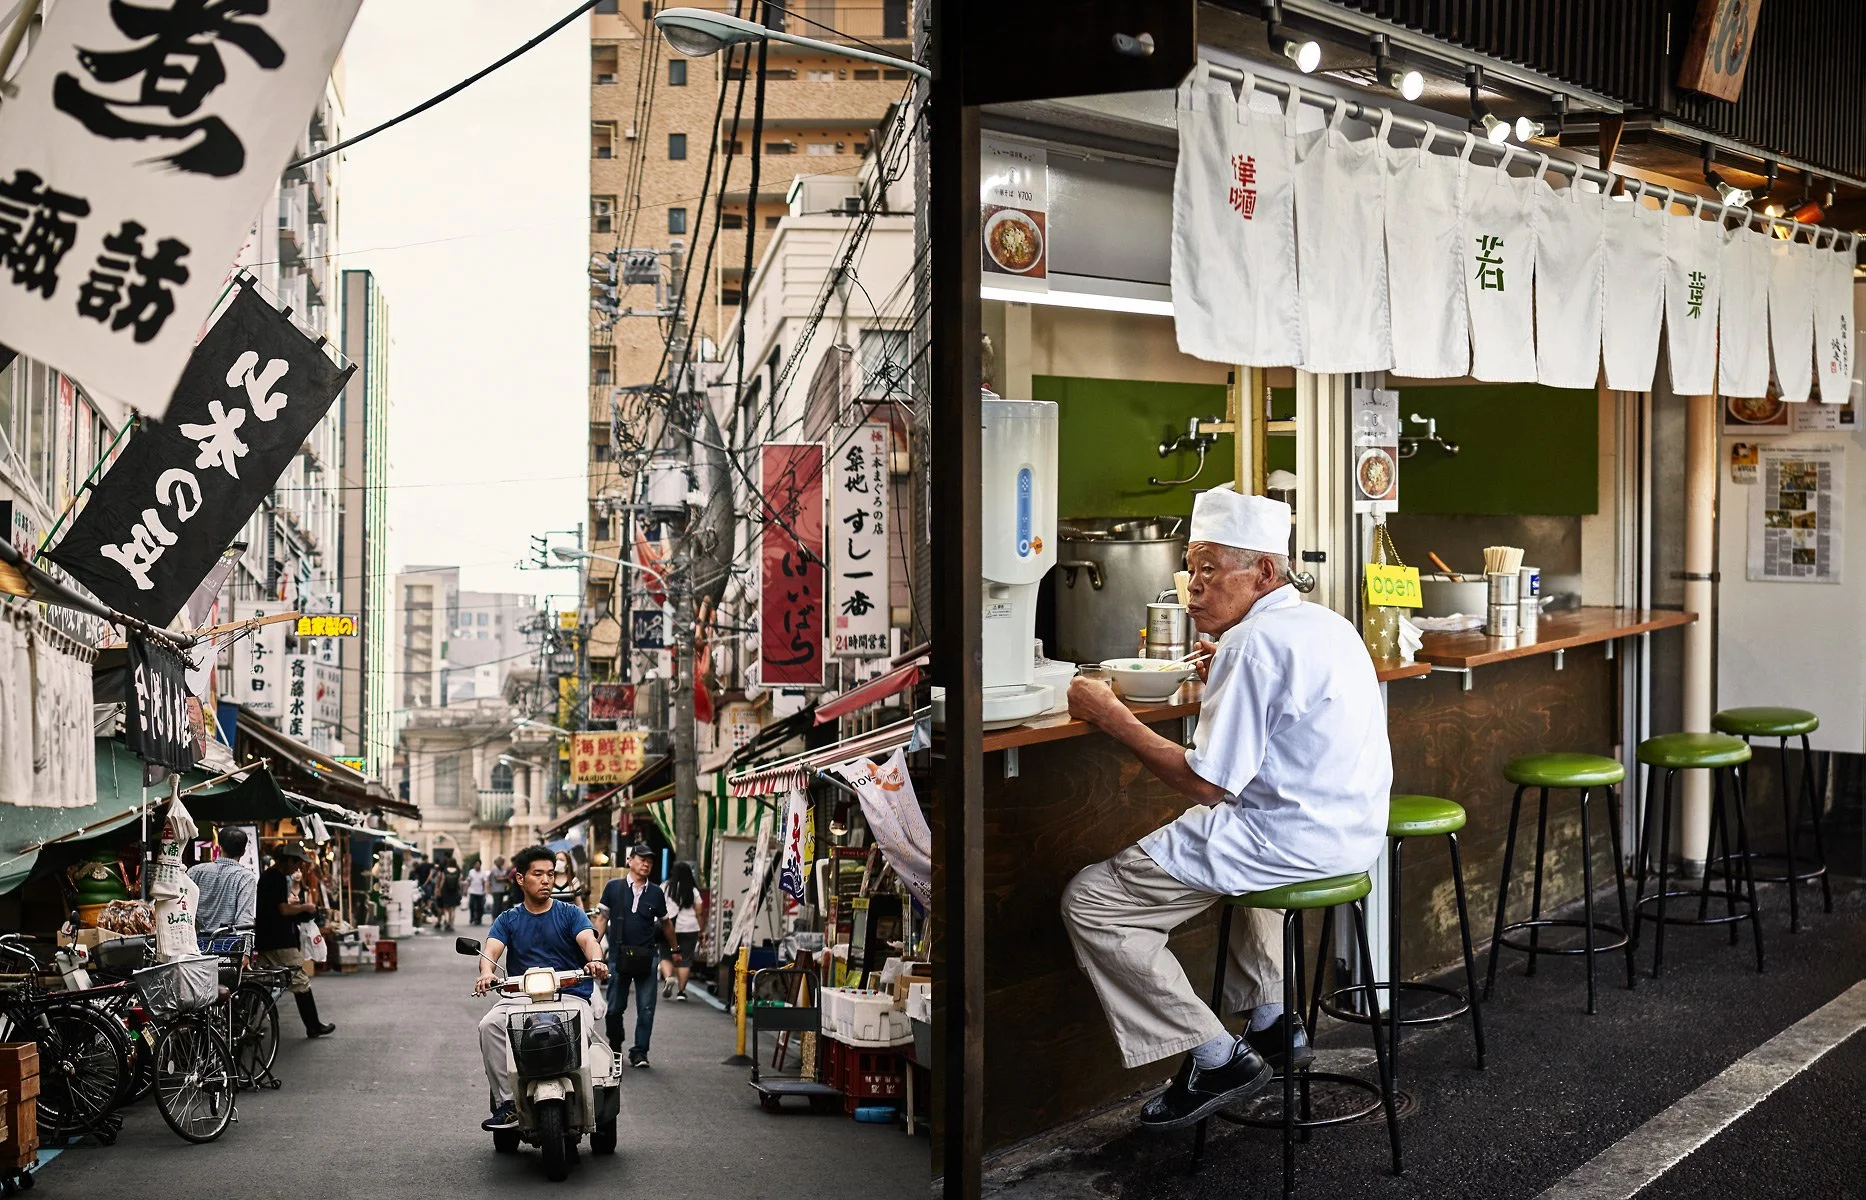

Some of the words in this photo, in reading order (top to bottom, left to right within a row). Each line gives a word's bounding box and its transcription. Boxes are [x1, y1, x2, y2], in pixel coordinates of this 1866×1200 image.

[1018, 190, 1033, 201] ¥700
[0, 169, 191, 343] 諏訪
[1475, 234, 1505, 291] 若
[1686, 271, 1707, 319] 葉
[870, 429, 884, 535] 極上本まぐろの店
[1373, 575, 1416, 602] open
[297, 615, 353, 637] 自家製の
[835, 634, 888, 651] 24時間営業
